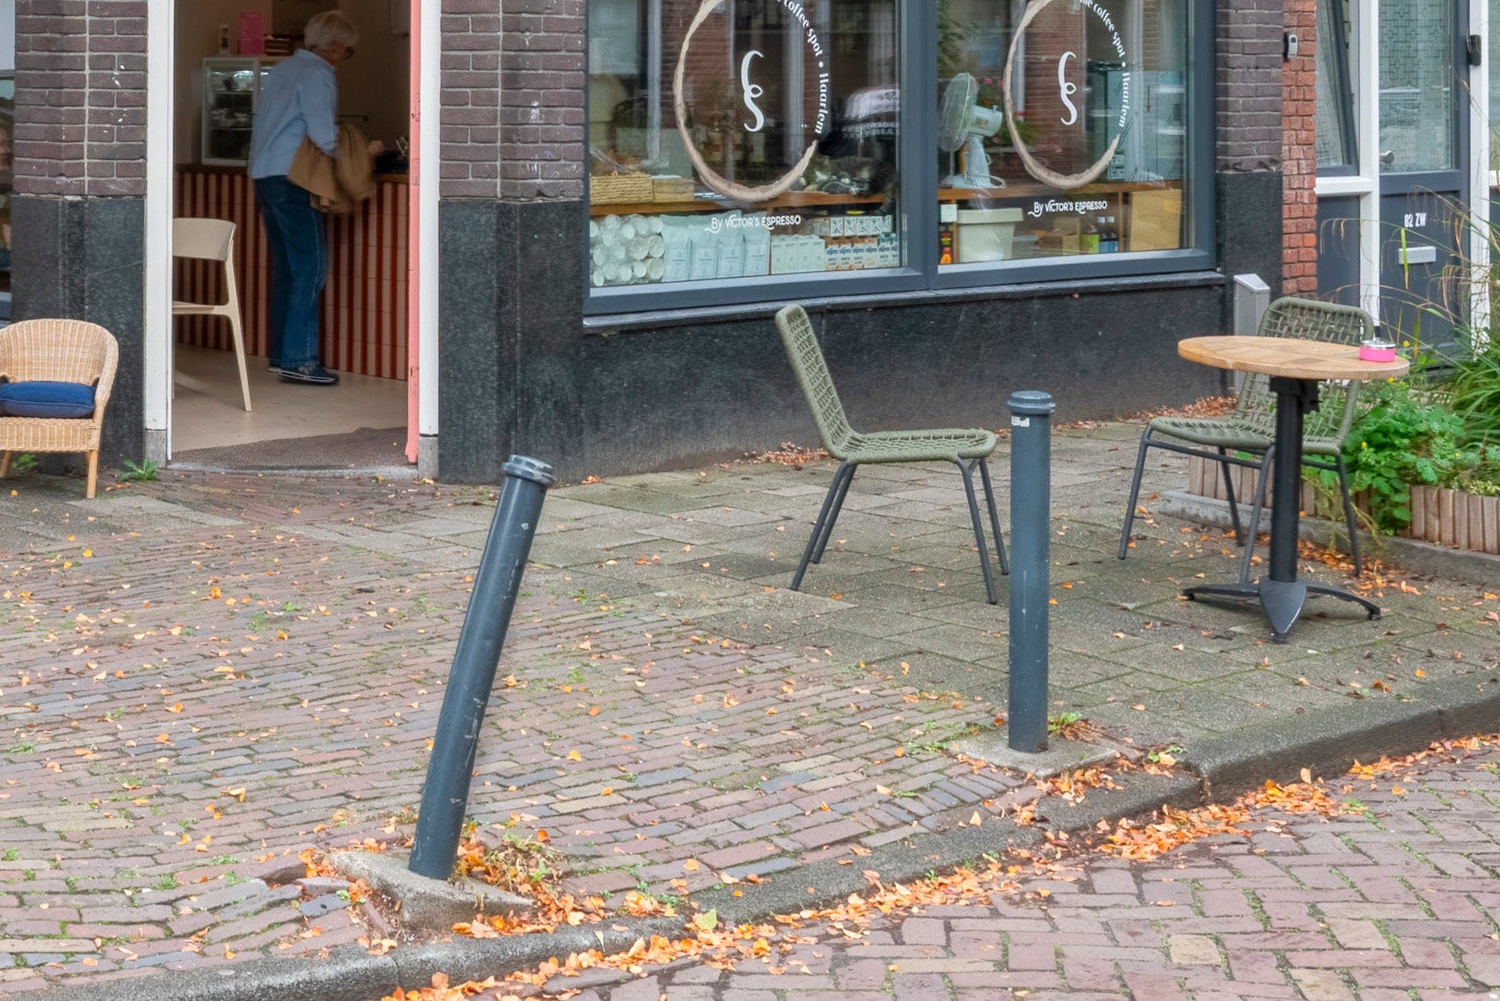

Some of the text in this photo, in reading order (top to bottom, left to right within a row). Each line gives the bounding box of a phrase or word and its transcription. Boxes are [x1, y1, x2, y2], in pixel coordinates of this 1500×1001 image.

[1093, 3, 1115, 32] coffee
[1112, 31, 1126, 58] spot
[806, 28, 824, 57] spot
[815, 72, 829, 134] Haarlem
[1118, 72, 1131, 128] Haarlem
[1074, 200, 1108, 215] ESPRESSO
[1404, 212, 1427, 228] 82 ZW
[761, 215, 801, 230] ESPRESSO
